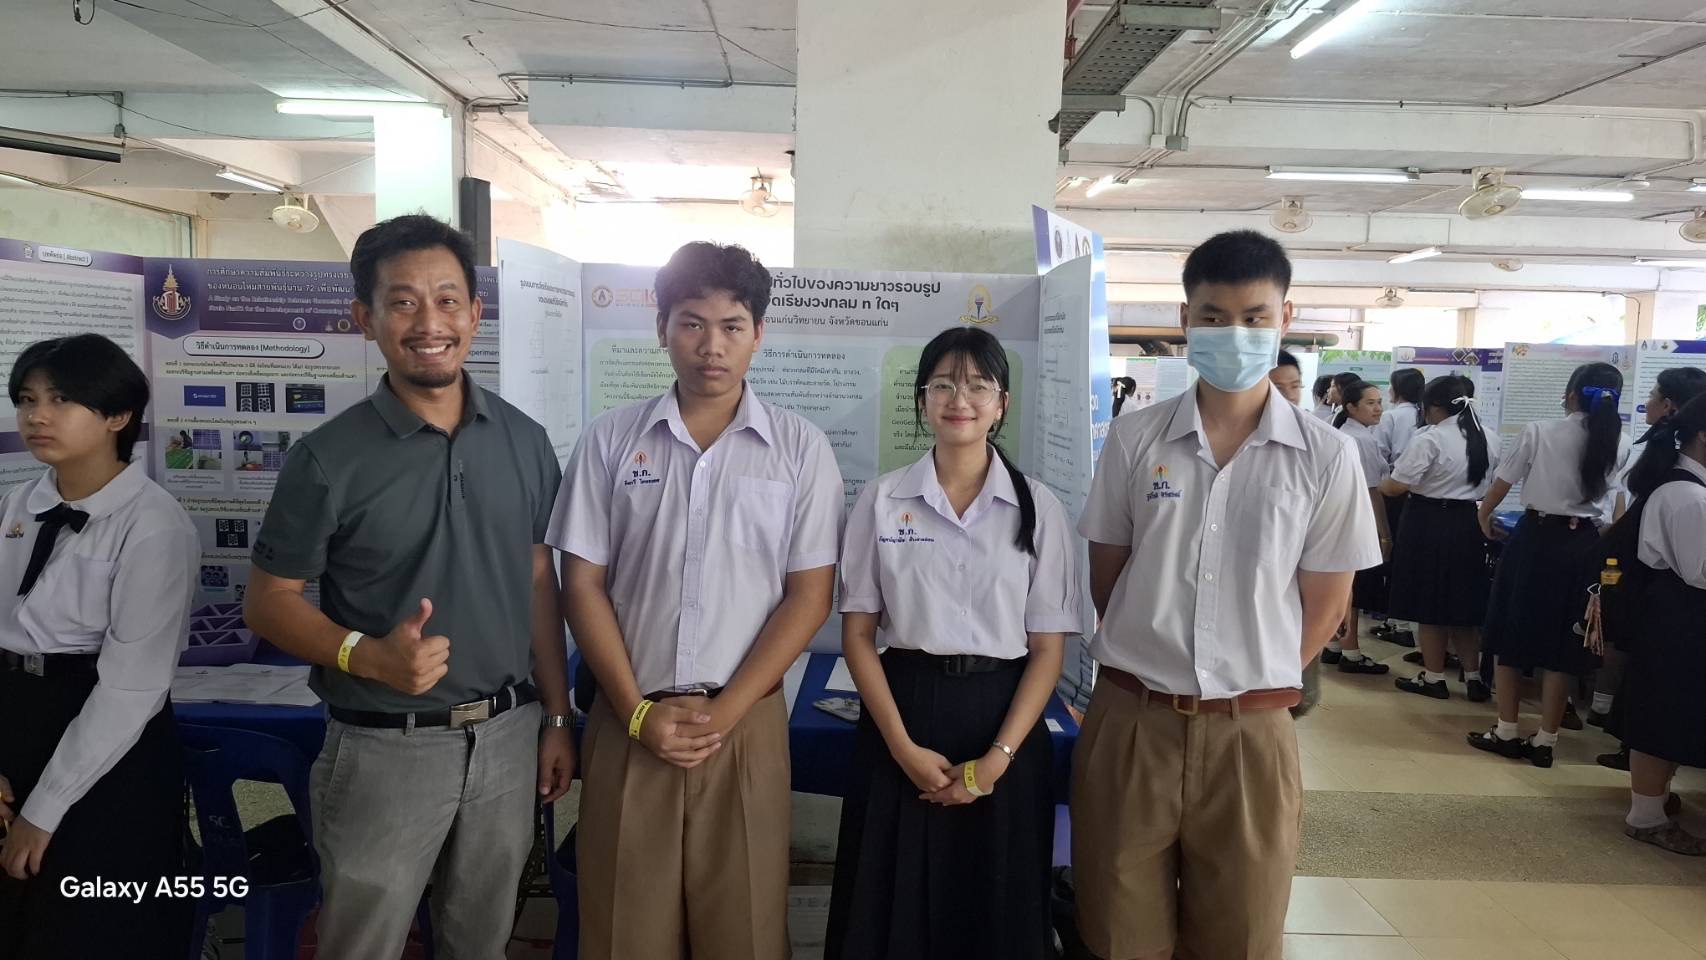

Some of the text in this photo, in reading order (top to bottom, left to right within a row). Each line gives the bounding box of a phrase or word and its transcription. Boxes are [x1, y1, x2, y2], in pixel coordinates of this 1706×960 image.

[771, 293, 858, 309] ดเรียงวงกลม
[764, 315, 826, 326] อนแก่นวิทยายน
